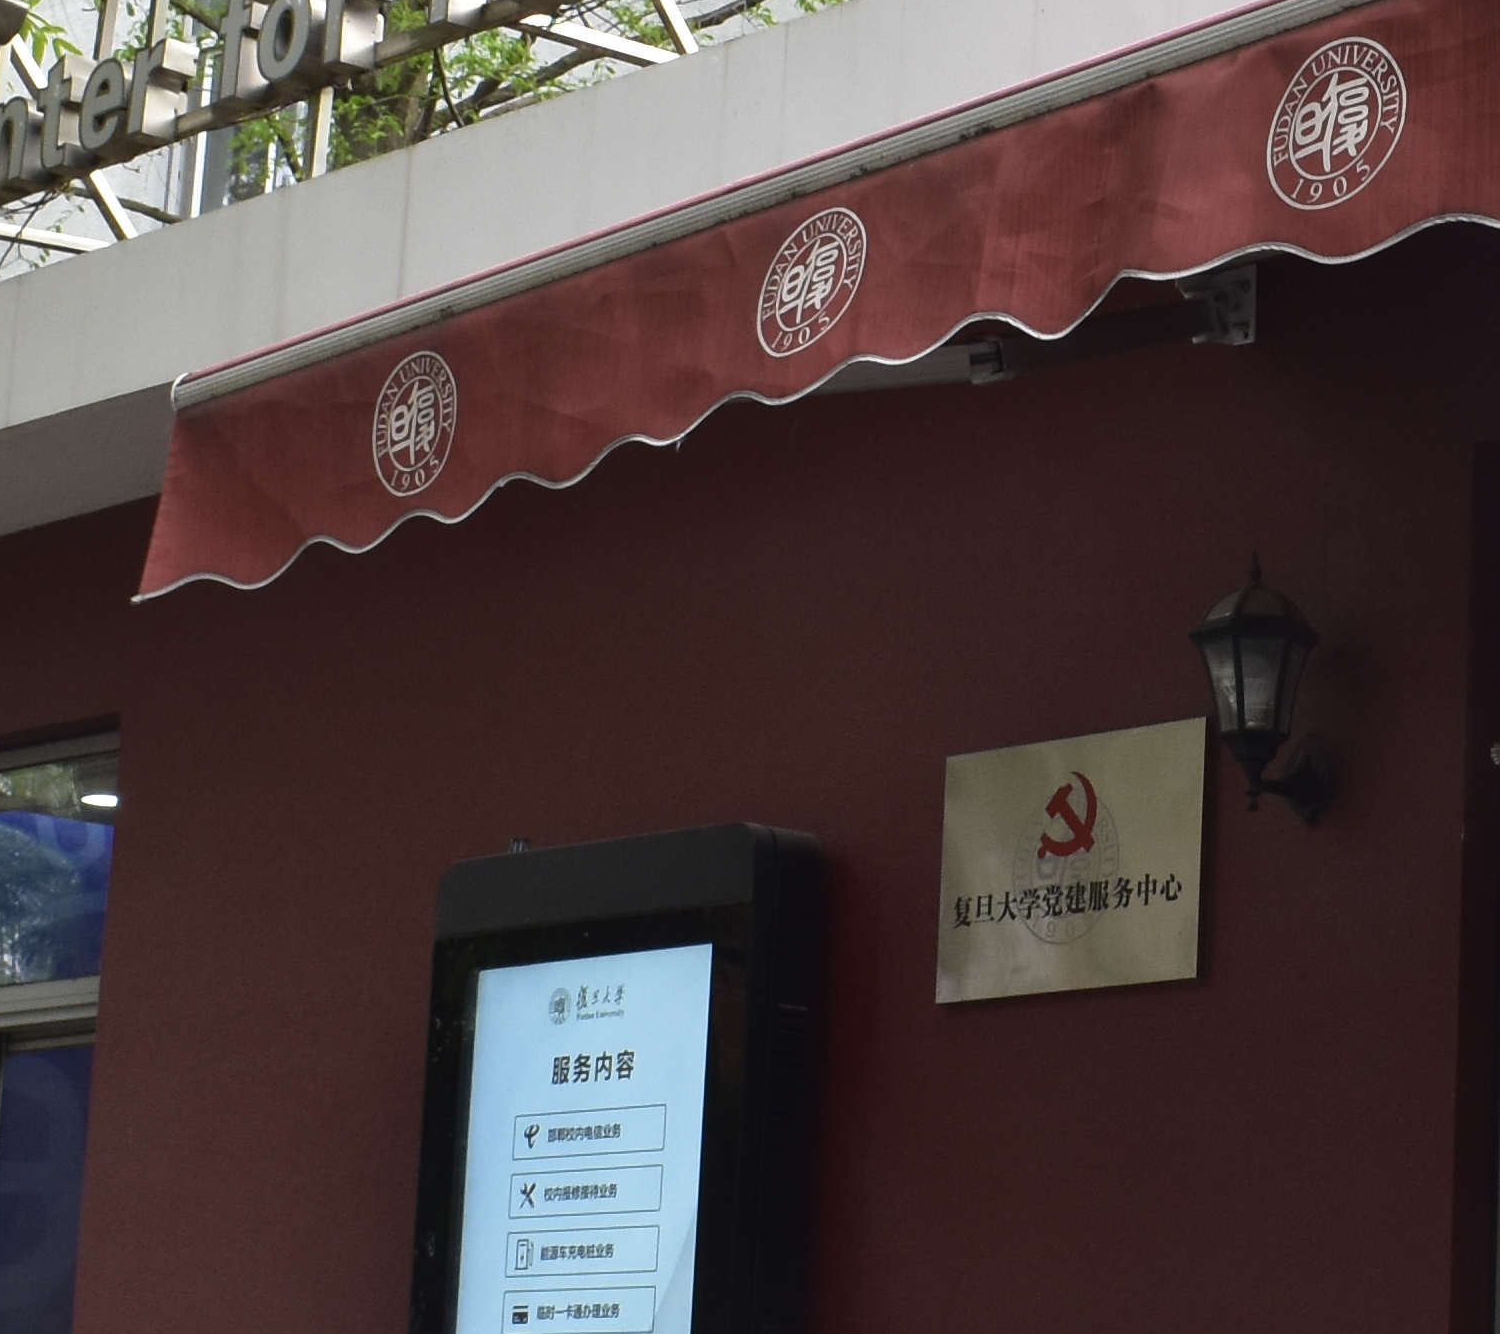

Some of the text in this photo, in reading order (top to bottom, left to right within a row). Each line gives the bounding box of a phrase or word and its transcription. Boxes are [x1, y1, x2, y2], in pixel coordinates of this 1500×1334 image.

[1273, 44, 1399, 168] FUDAN UNIVERSITY
[1291, 158, 1371, 204] 1905
[953, 872, 1183, 930] 复旦大学党建服务中心
[551, 1050, 636, 1086] 服务内容
